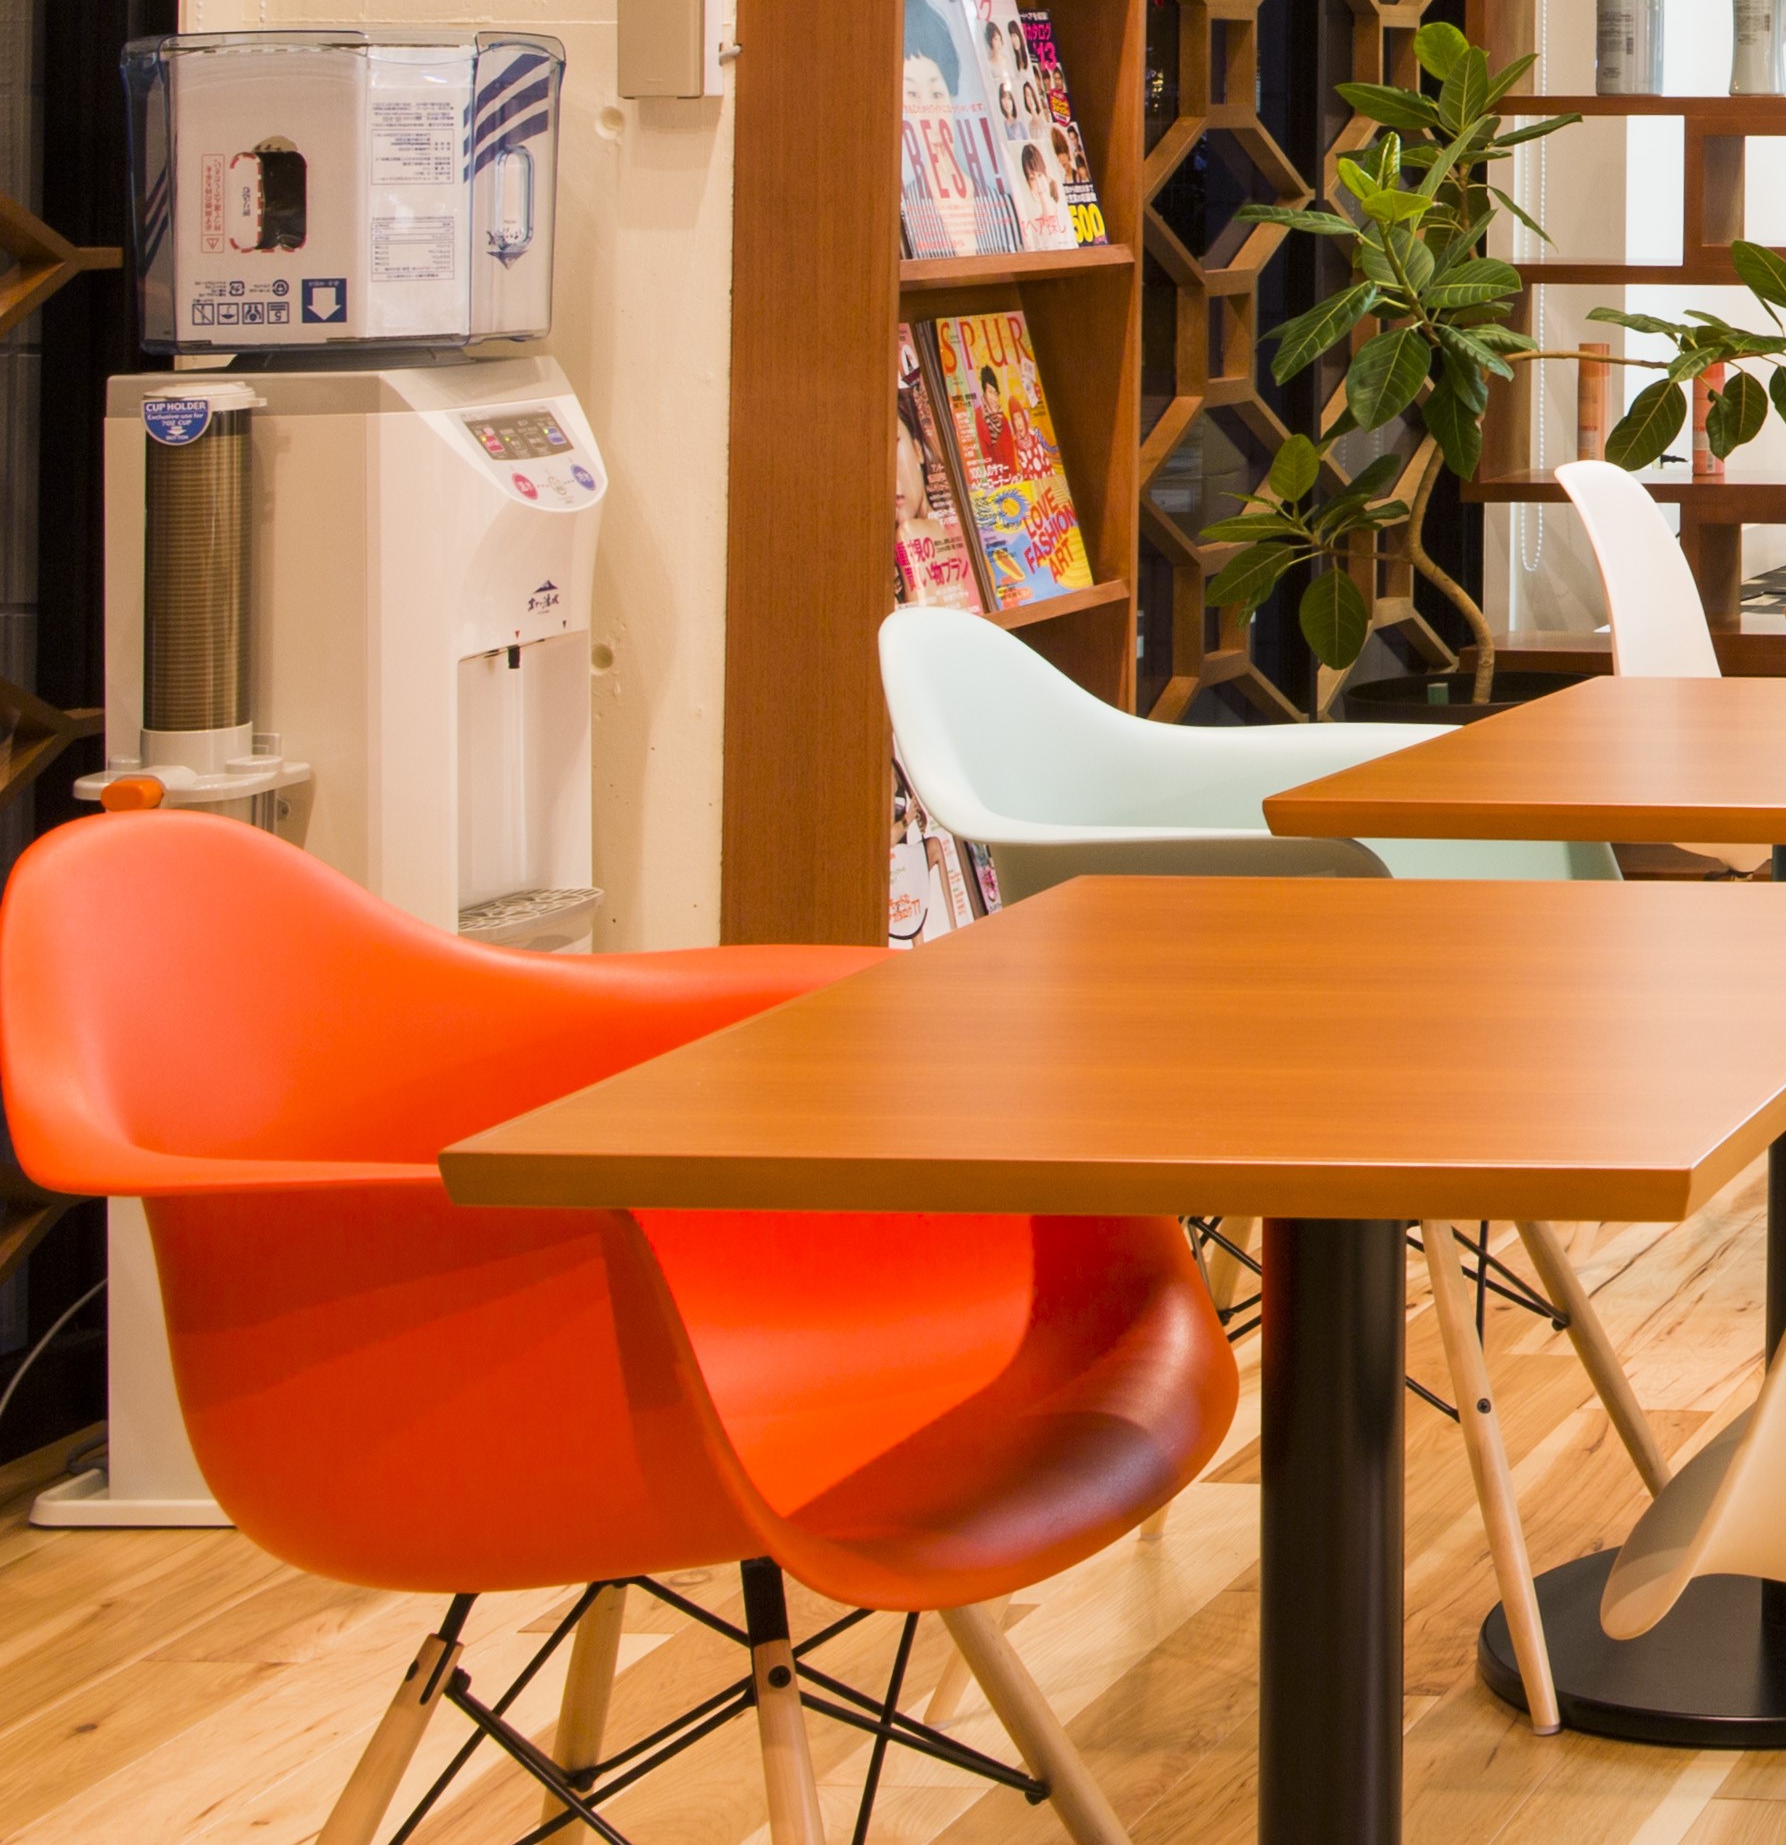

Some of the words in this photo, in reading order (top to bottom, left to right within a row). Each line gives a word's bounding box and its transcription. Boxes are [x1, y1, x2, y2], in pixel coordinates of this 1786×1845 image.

[899, 117, 1006, 199] RESH!
[940, 316, 1035, 374] SPUR
[146, 403, 166, 412] CUP
[167, 402, 206, 411] HOLDER
[1022, 486, 1059, 541] LOVE
[1024, 499, 1077, 575] FASHION
[1048, 537, 1075, 584] ART
